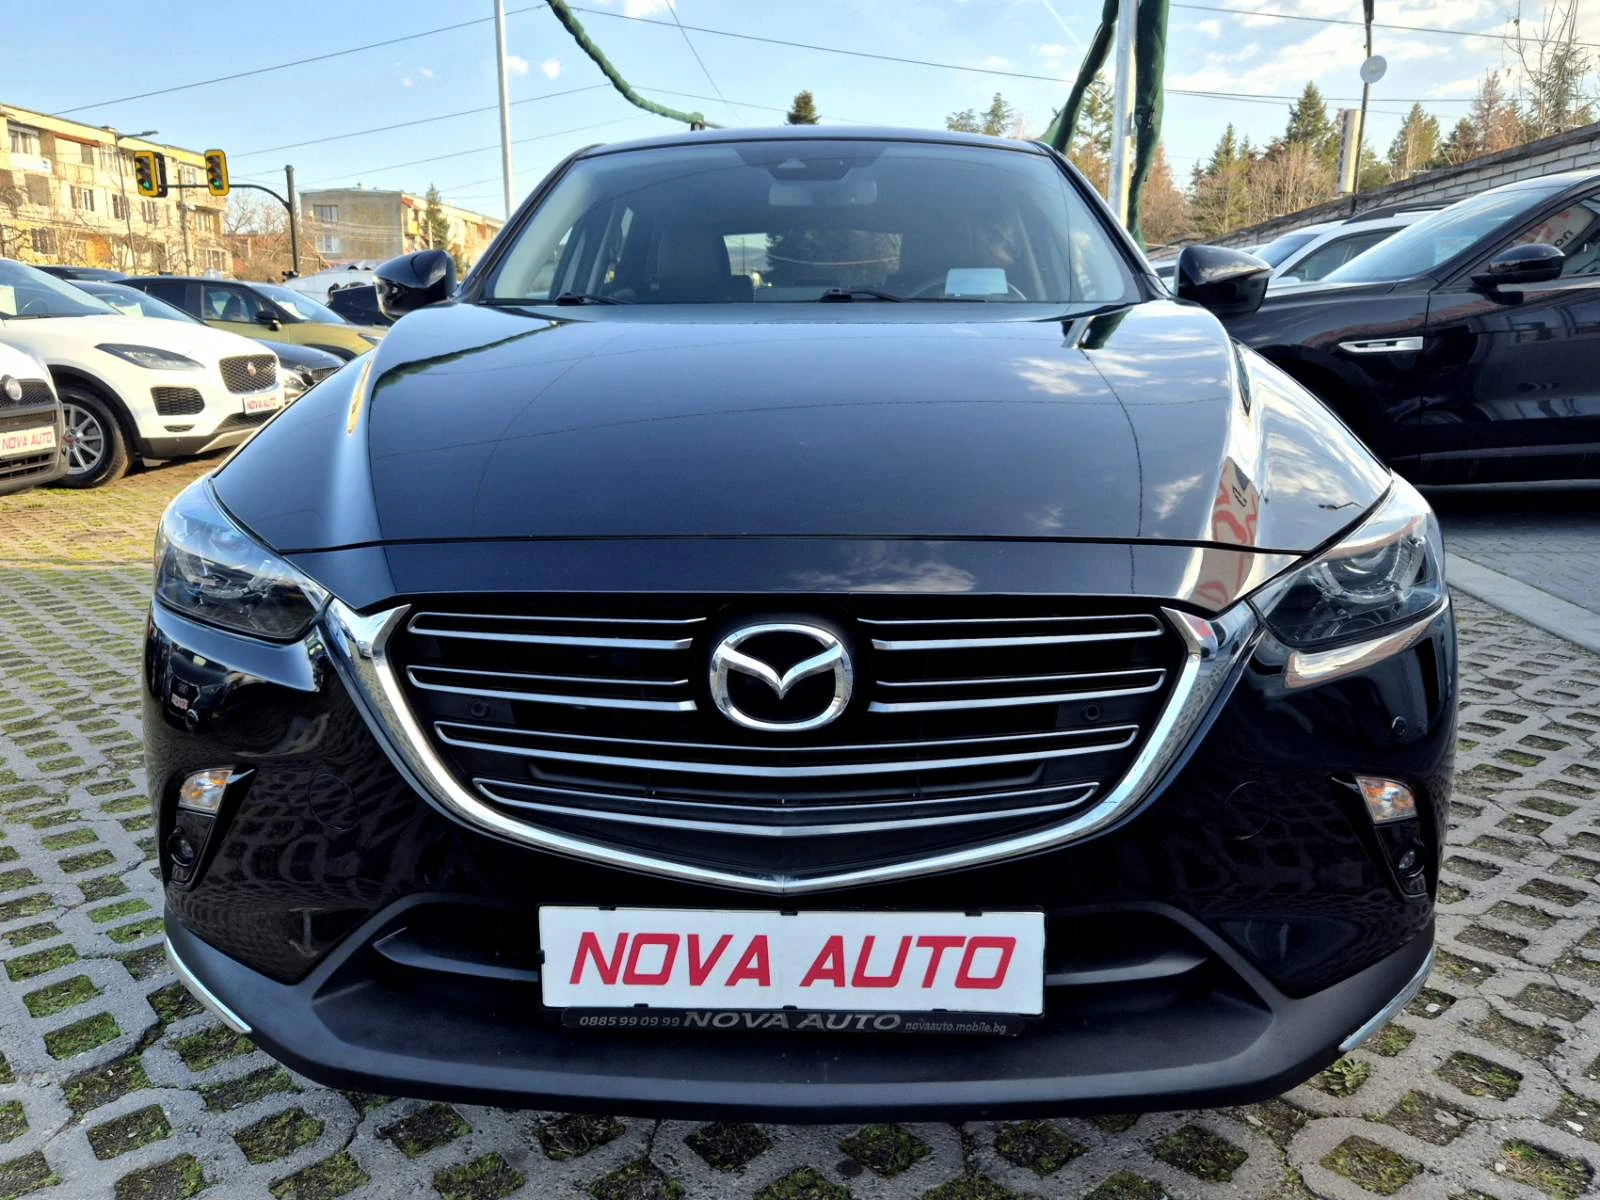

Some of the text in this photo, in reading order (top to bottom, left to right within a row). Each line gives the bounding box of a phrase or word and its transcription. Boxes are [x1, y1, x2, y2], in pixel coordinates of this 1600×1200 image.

[2, 431, 53, 449] NOVA AUTO
[569, 931, 1017, 990] NOVA AUTO
[579, 1011, 1007, 1034] 0885 99 09 99 NOVA AUTO novaauto.mobile.bg
